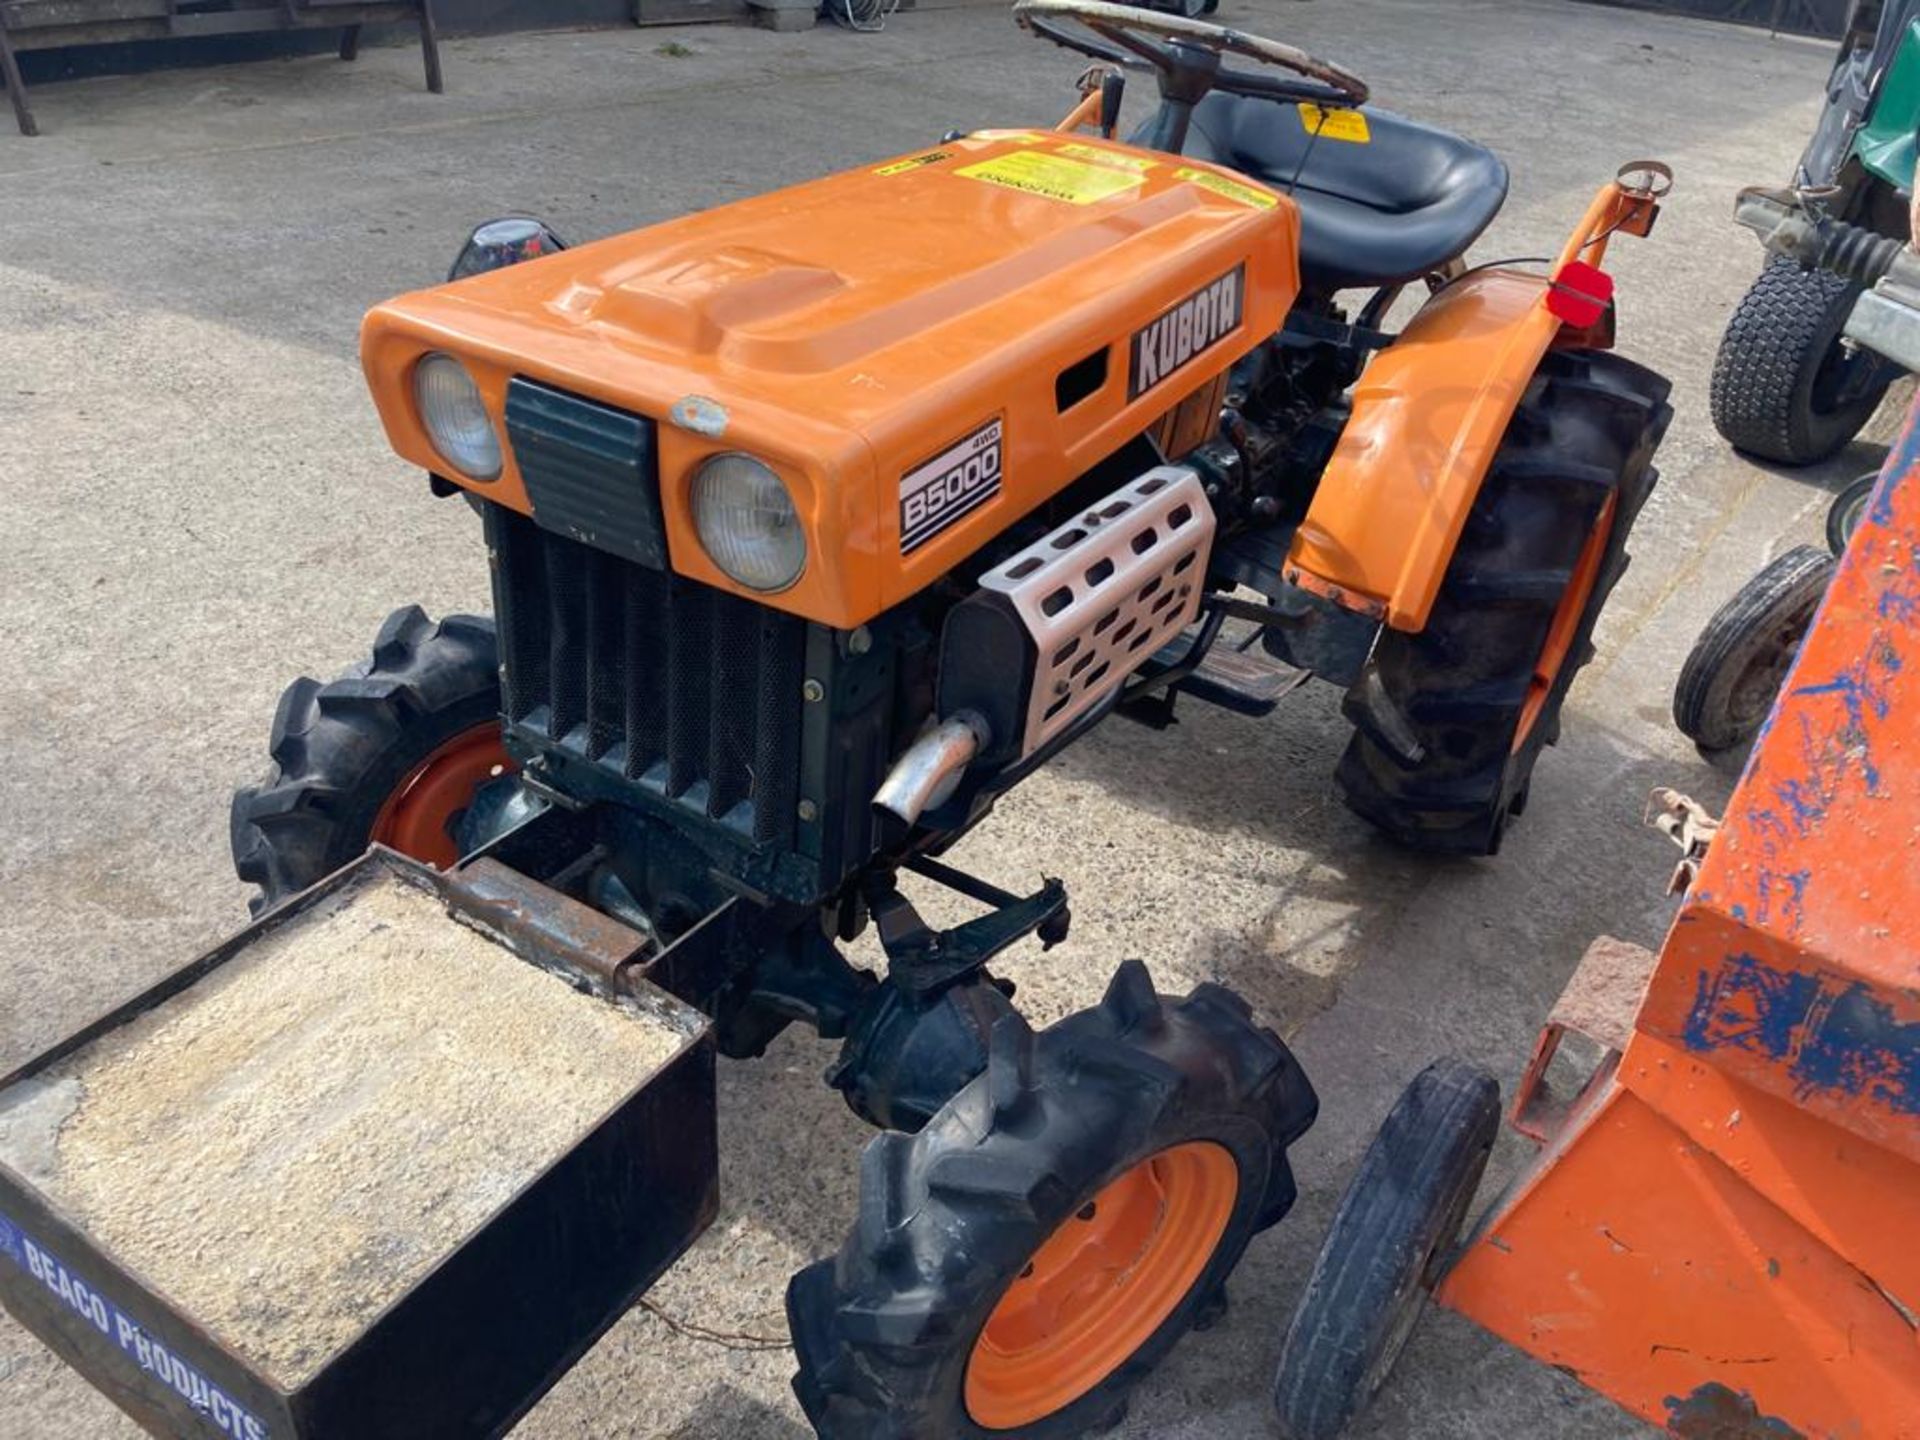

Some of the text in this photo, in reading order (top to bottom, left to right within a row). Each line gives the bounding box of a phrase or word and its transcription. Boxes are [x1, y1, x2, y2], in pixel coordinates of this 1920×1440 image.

[1138, 271, 1237, 393] KUBOTA
[904, 444, 999, 532] B5000
[972, 426, 999, 450] 4WD
[23, 1238, 265, 1440] BEACO PRODUCTS
